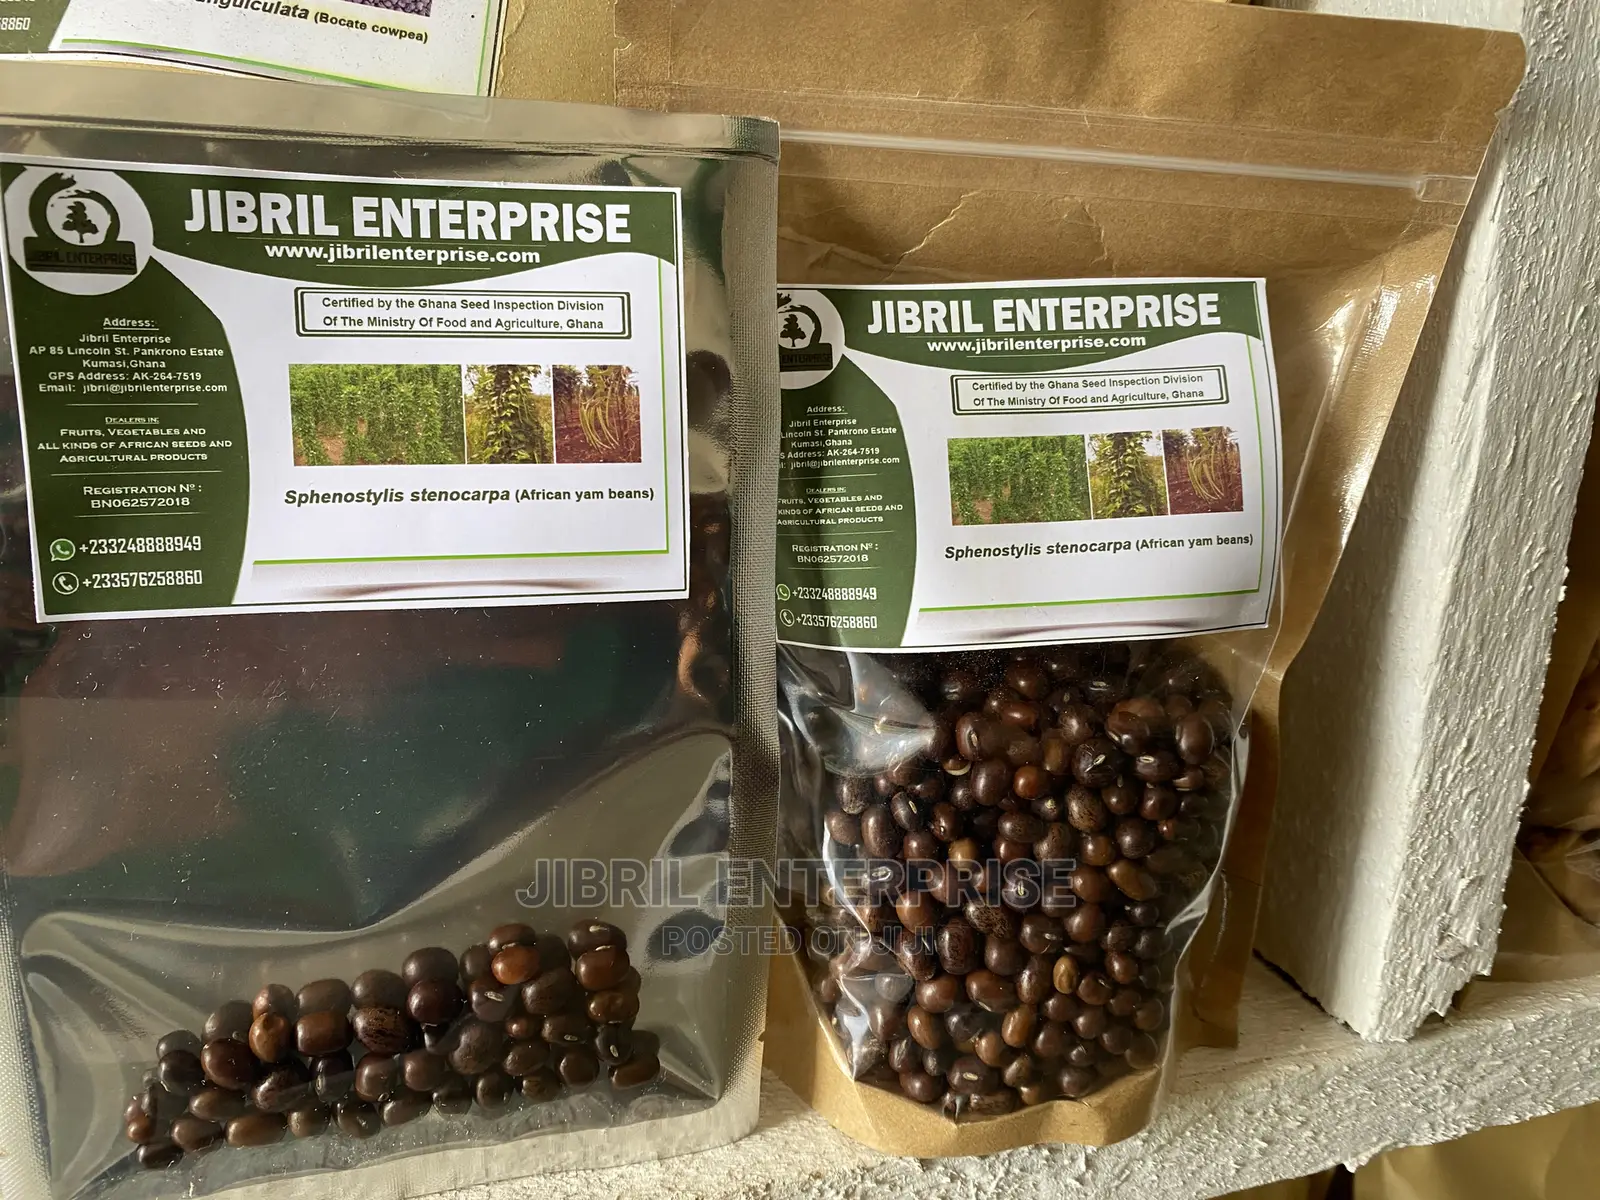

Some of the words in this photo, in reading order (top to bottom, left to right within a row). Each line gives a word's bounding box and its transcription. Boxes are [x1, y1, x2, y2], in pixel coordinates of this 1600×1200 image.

[0, 17, 30, 30] 8860
[195, 0, 309, 19] guiculata
[314, 12, 366, 30] (Bocate
[372, 24, 428, 44] cowpea)
[185, 188, 339, 236] JIBRIL
[352, 197, 631, 243] ENTERPRISE
[265, 243, 540, 264] www.jibrilenterprise.com
[322, 298, 373, 308] Certified
[378, 299, 391, 310] by
[396, 299, 414, 308] the
[418, 299, 457, 309] Ghana
[460, 300, 489, 309] Seed
[493, 300, 553, 312] Inspection
[557, 301, 604, 311] Division
[867, 300, 983, 334] JIBRIL
[994, 294, 1221, 332] ENTERPRISE
[103, 318, 154, 327] Address:
[323, 317, 337, 326] Of
[341, 317, 363, 326] The
[367, 317, 415, 329] Ministry
[419, 318, 434, 327] Of
[437, 318, 466, 327] Food
[470, 318, 491, 328] and
[495, 318, 563, 330] Agriculture,
[566, 319, 604, 329] Ghana
[79, 334, 109, 343] Jibril
[113, 335, 171, 344] Enterprise
[927, 334, 1146, 354] www.jibrilenterprise.com
[67, 347, 110, 355] Lincoln
[115, 347, 129, 355] St.
[134, 348, 186, 356] Pankrono
[190, 348, 224, 356] Estate
[49, 372, 74, 380] GPS
[78, 372, 129, 380] Address:
[83, 384, 227, 394] jibril@jibrilenterprise.com
[972, 382, 1013, 391] Certified
[1015, 381, 1027, 392] by
[1030, 381, 1045, 390] the
[1048, 381, 1079, 389] Ghana
[1082, 379, 1106, 388] Seed
[1109, 377, 1160, 389] Inspection
[1163, 375, 1203, 385] Division
[973, 398, 985, 406] Of
[1008, 397, 1046, 407] Ministry
[1050, 396, 1060, 405] Of
[1063, 395, 1087, 404] Food
[1091, 395, 1108, 403] and
[1111, 393, 1169, 404] Agriculture,
[1172, 389, 1204, 399] Ghana
[814, 418, 857, 426] Enterprise
[827, 448, 879, 456] AK-264-7519
[791, 457, 900, 469] jibril@jibrilenterprise.com
[91, 498, 190, 508] BN062572018
[285, 489, 404, 507] Sphenostylis
[410, 490, 510, 503] stenocarpa
[515, 489, 571, 502] (African
[575, 491, 604, 502] yam
[608, 488, 654, 501] beans)
[80, 536, 201, 554] +233248888949
[945, 544, 1041, 560] Sphenostylis
[1046, 541, 1131, 555] stenocarpa
[1136, 538, 1184, 551] (African
[1188, 538, 1213, 548] yam
[1217, 534, 1253, 547] beans)
[797, 555, 868, 563] BN062572018
[83, 570, 202, 588] +233576258860
[793, 587, 877, 600] +233248888949
[797, 614, 877, 629] +233576258860
